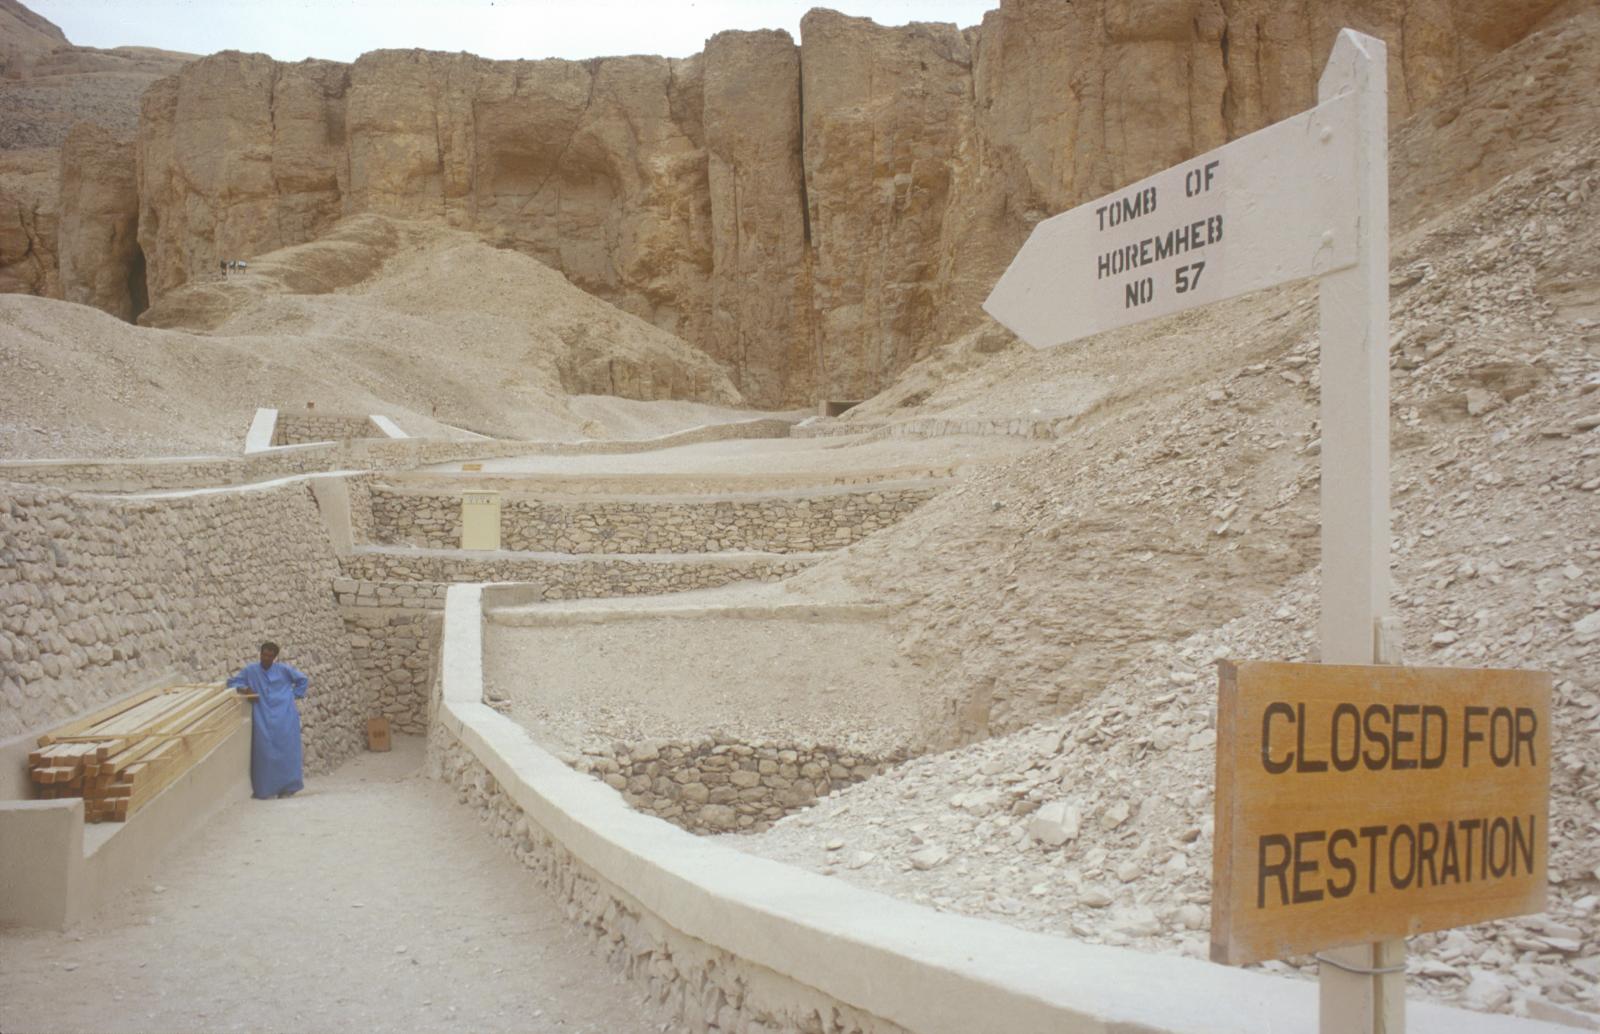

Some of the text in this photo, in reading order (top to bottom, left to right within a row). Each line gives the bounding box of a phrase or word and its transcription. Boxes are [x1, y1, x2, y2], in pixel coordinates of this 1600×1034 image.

[1096, 160, 1220, 231] TOMB OF
[1098, 215, 1223, 279] HOREMHEB
[1125, 261, 1206, 308] NO 57
[1262, 702, 1538, 774] CLOSED FOR
[1257, 814, 1536, 909] RESTORATION
